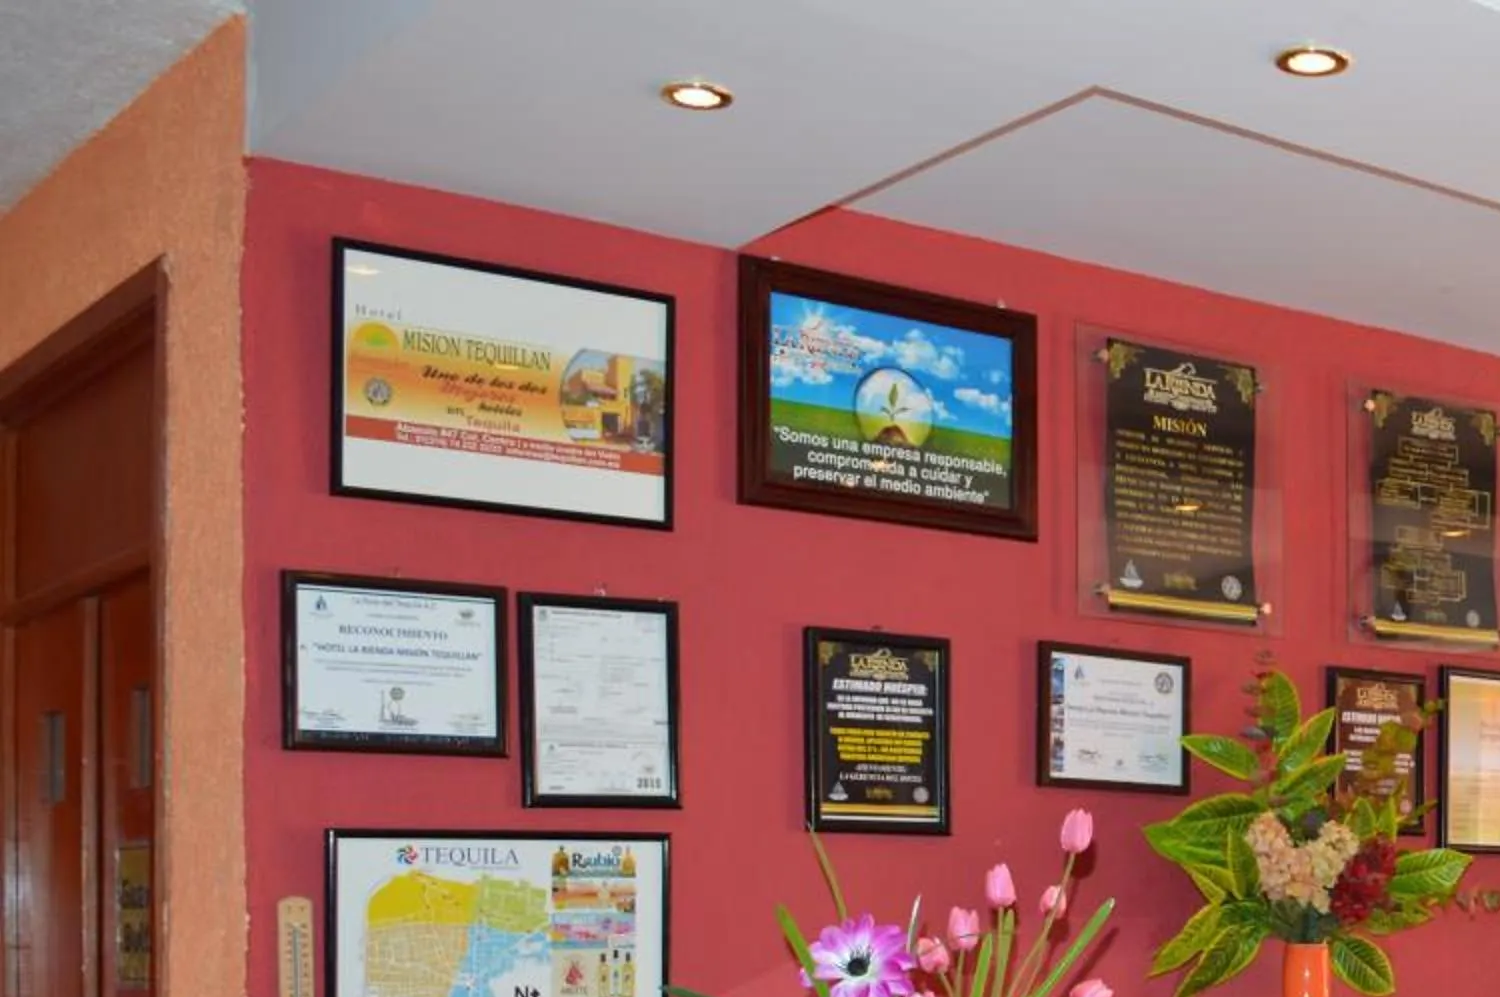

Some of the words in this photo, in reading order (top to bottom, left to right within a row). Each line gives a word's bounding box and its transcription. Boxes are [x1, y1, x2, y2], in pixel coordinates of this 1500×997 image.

[403, 329, 461, 357] MISION
[466, 339, 551, 371] TEQUILLAN
[807, 450, 905, 477] compromda
[909, 464, 918, 478] a
[921, 467, 962, 485] cuidar
[965, 475, 974, 489] y
[832, 437, 858, 453] una
[862, 442, 921, 461] empresa
[924, 452, 1008, 478] responsable,
[793, 465, 861, 489] preservar
[863, 474, 877, 488] el
[880, 477, 921, 495] medio
[420, 847, 519, 867] TEQUILA
